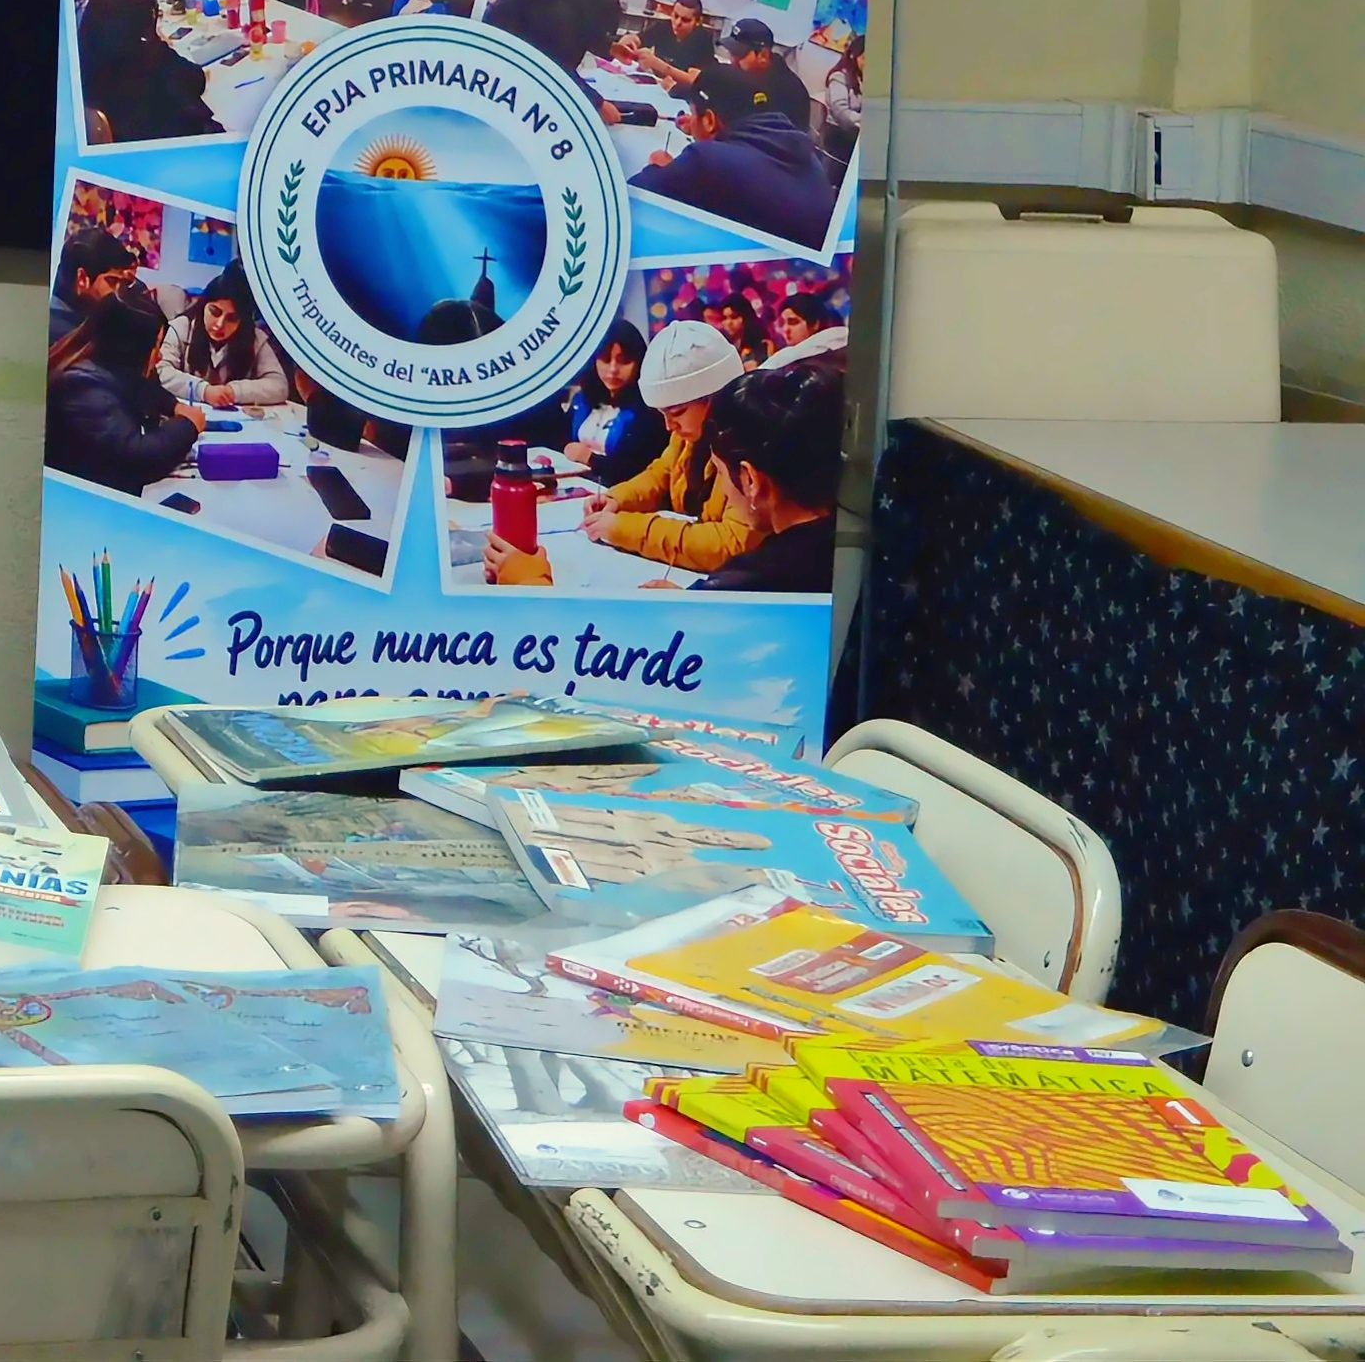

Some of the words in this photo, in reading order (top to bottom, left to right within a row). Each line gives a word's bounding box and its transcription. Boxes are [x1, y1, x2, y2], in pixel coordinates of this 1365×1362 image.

[301, 78, 367, 139] EPJA
[368, 59, 518, 114] PRIMARIA
[291, 278, 380, 370] Tripulantes
[381, 358, 416, 384] del
[476, 349, 517, 381] SAN
[226, 609, 358, 677] Porque
[371, 620, 497, 666] nunca
[512, 632, 559, 670] es
[573, 624, 704, 694] tarde
[811, 820, 929, 925] Sociales
[1165, 1099, 1202, 1125] 1
